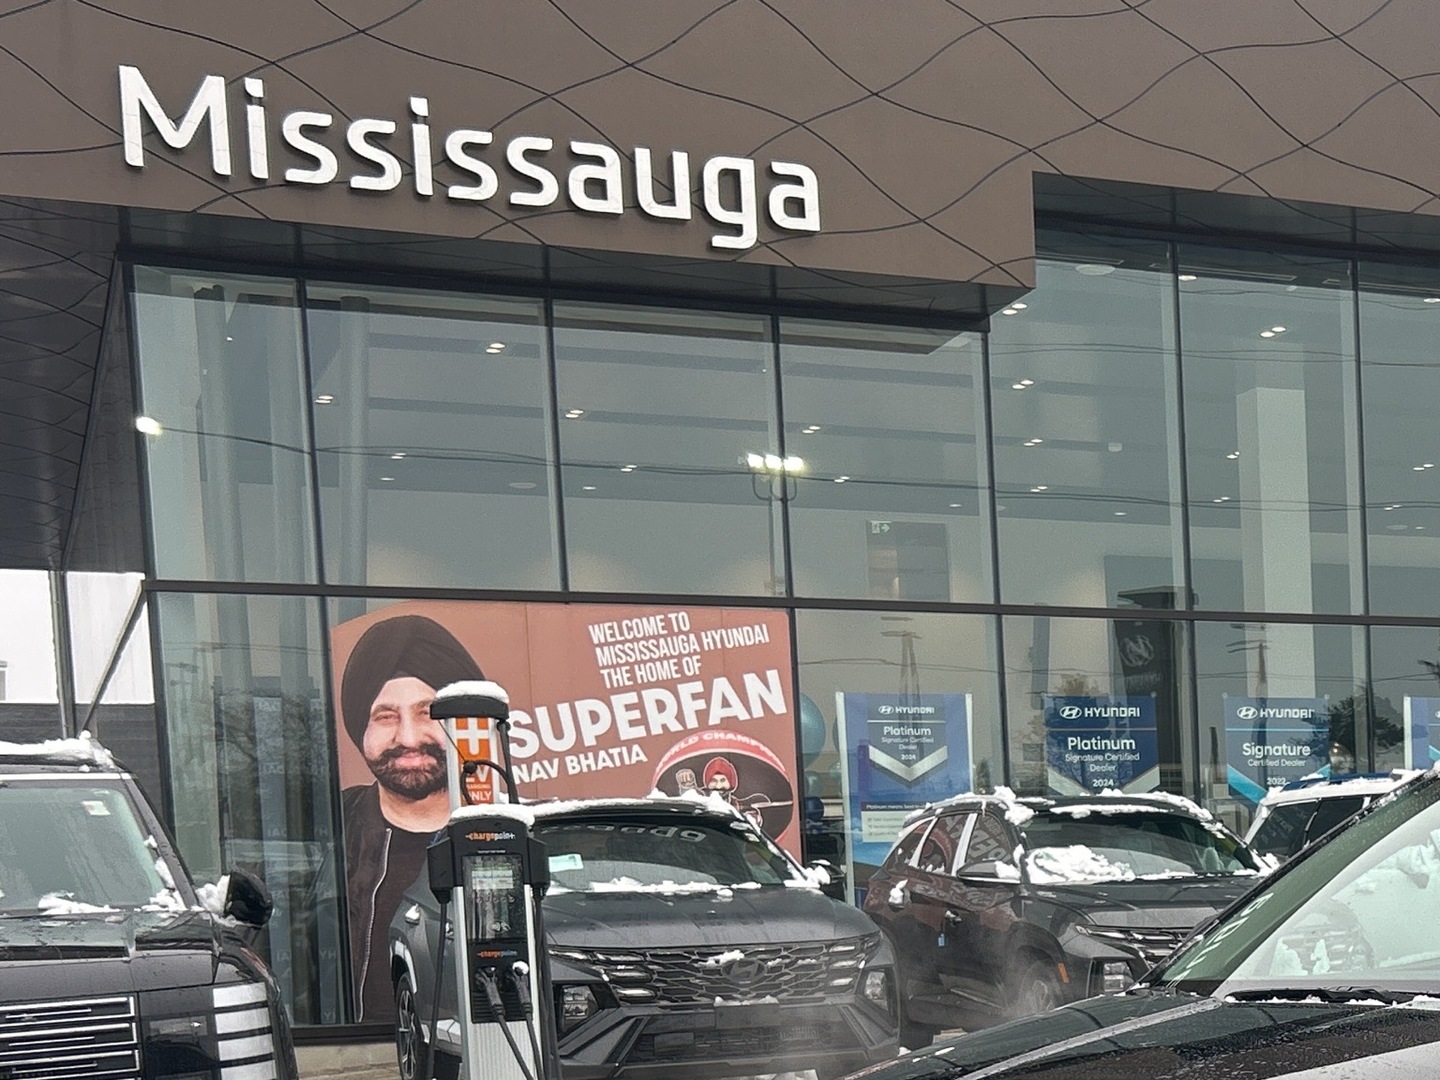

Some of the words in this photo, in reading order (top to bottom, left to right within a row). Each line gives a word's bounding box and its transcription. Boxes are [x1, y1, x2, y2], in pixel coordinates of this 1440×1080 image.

[118, 65, 822, 250] Mississauga
[588, 614, 667, 644] WELCOME
[669, 610, 690, 632] TO
[595, 632, 700, 666] MISSISSAUGA
[702, 623, 769, 651] HYUNDAI
[600, 666, 633, 688] THE
[636, 659, 681, 684] HOME
[683, 655, 702, 676] OF
[508, 668, 788, 759] SUPERFAN
[895, 706, 934, 714] HYUNDAI
[1084, 707, 1140, 717] HYUNDAI
[1260, 708, 1313, 718] HYUNDAI
[883, 725, 931, 735] Platinum
[1067, 736, 1136, 750] Platinum
[1242, 742, 1311, 758] Signature
[1065, 753, 1103, 763] Signature
[1104, 752, 1140, 761] Certified
[1247, 758, 1280, 767] Certified
[1281, 758, 1306, 766] Dealer
[513, 762, 559, 785] NAV
[565, 743, 648, 777] BHATIA
[1089, 763, 1116, 772] Dealer
[1092, 779, 1114, 787] 2024
[1266, 777, 1286, 785] 2022
[468, 790, 492, 801] NLY
